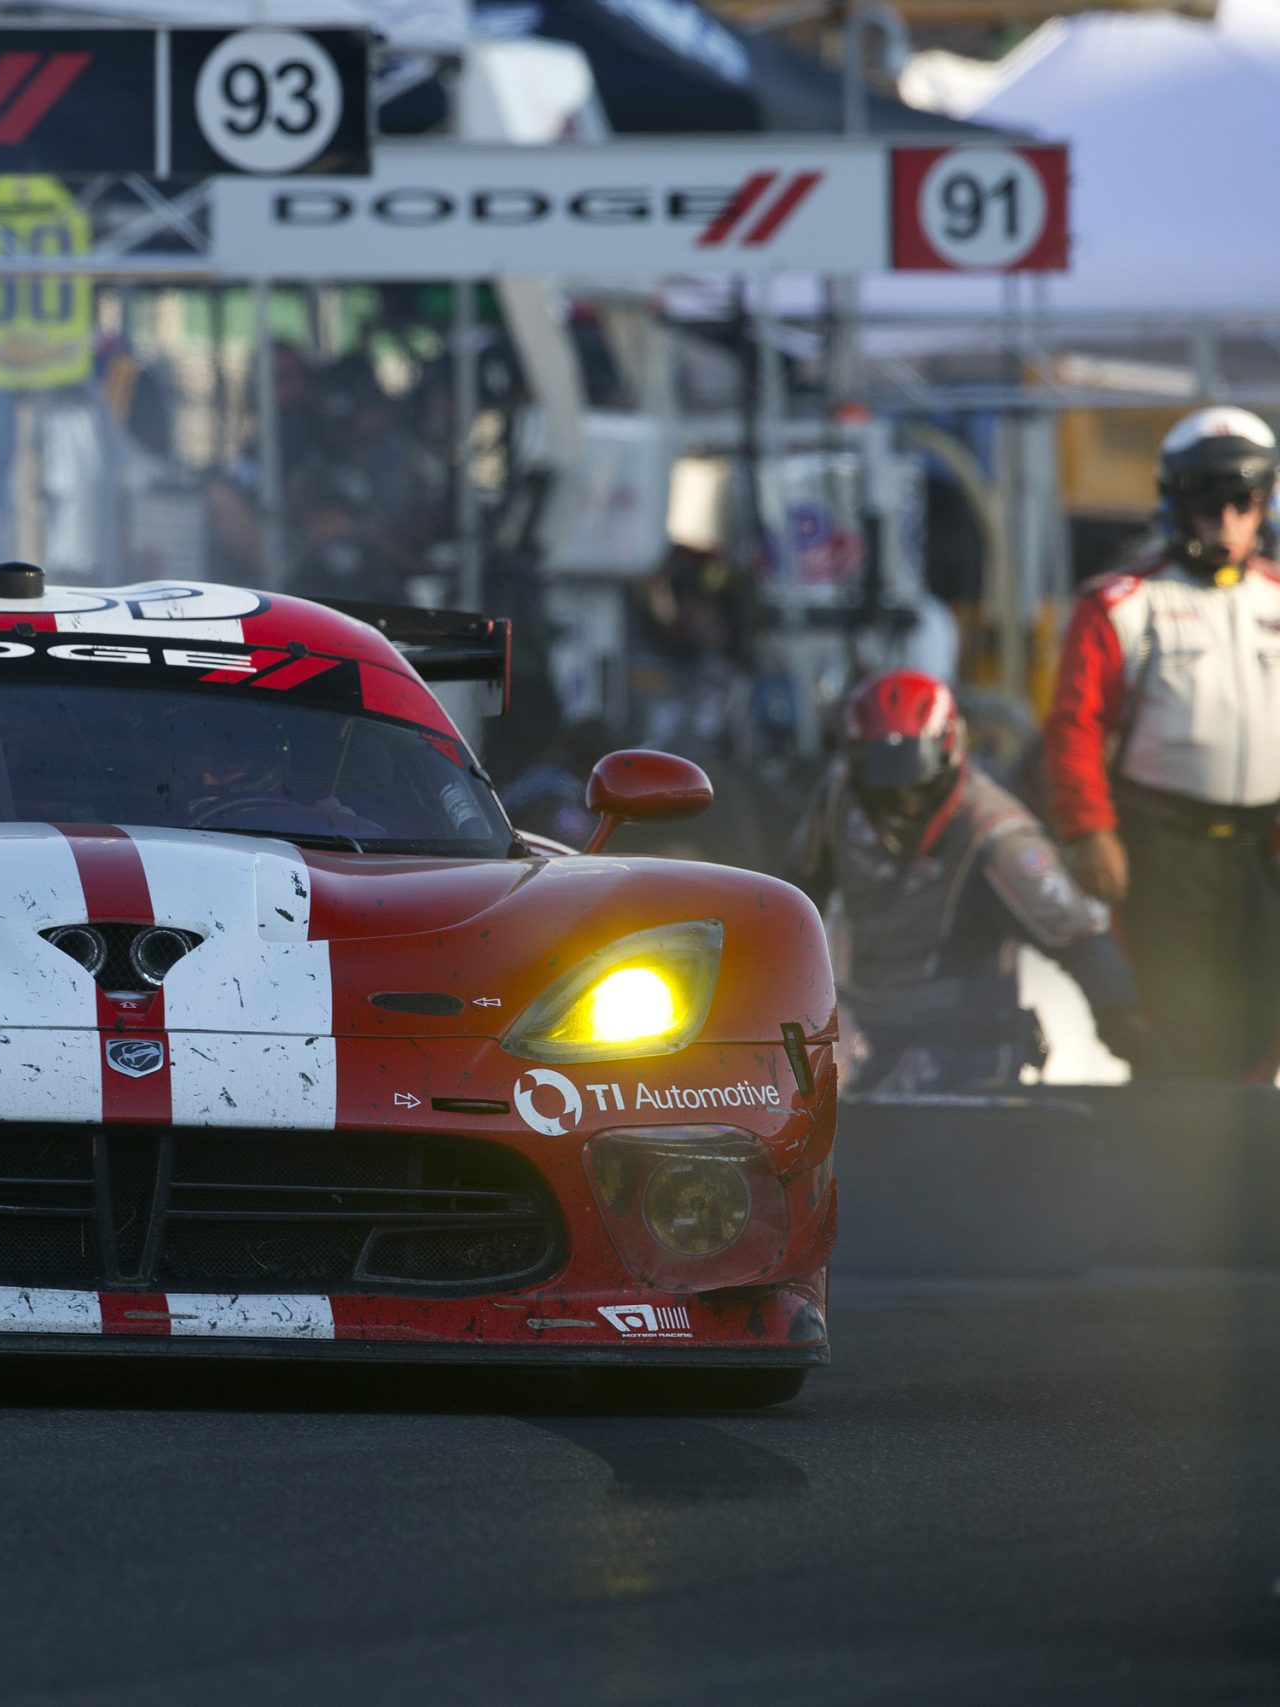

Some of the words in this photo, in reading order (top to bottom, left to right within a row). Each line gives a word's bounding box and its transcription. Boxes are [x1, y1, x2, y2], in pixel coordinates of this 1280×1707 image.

[222, 61, 320, 137] 93
[271, 187, 744, 227] DODGE
[941, 171, 1019, 243] 91
[585, 1082, 625, 1112] TI
[635, 1079, 780, 1111] Automotive
